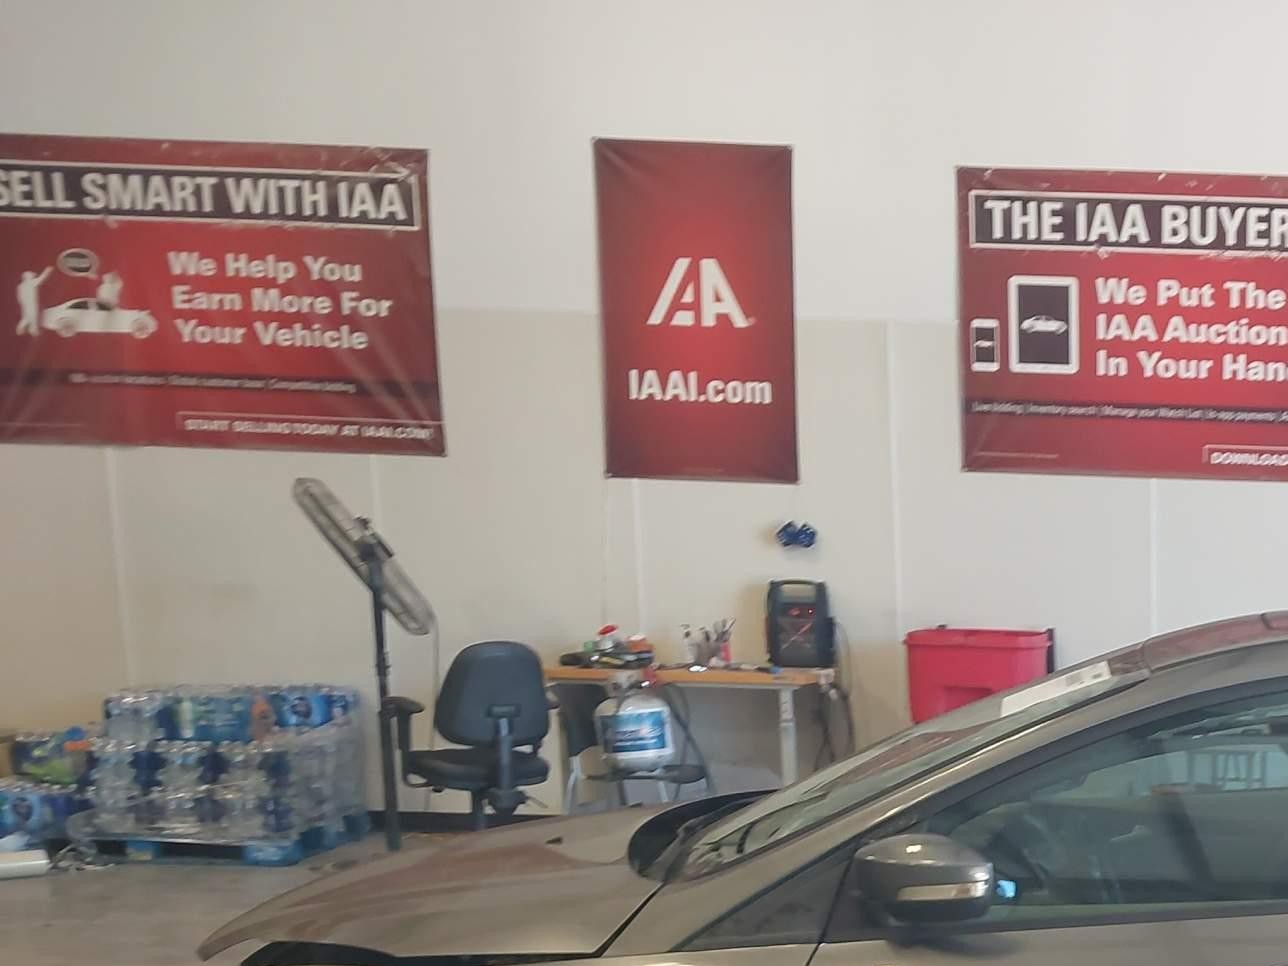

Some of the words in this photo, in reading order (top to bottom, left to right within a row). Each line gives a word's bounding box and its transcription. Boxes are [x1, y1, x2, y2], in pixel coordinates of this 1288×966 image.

[81, 172, 219, 212] SMART
[224, 177, 329, 217] WITH
[337, 181, 408, 220] IAA
[984, 199, 1065, 241] THE
[1075, 202, 1151, 244] IAA
[167, 251, 217, 277] We
[225, 253, 297, 284] Help
[303, 255, 363, 283] You
[171, 285, 242, 311] Earn
[251, 287, 333, 315] More
[341, 291, 393, 317] For
[1095, 276, 1147, 305] We
[1156, 278, 1216, 308] Put
[1223, 281, 1287, 310] The
[174, 318, 247, 344] Your
[253, 320, 369, 350] Vehicle
[1096, 313, 1158, 342] IAA
[1096, 349, 1128, 377] In
[1136, 350, 1214, 380] Your
[628, 368, 773, 405] IAAI.com
